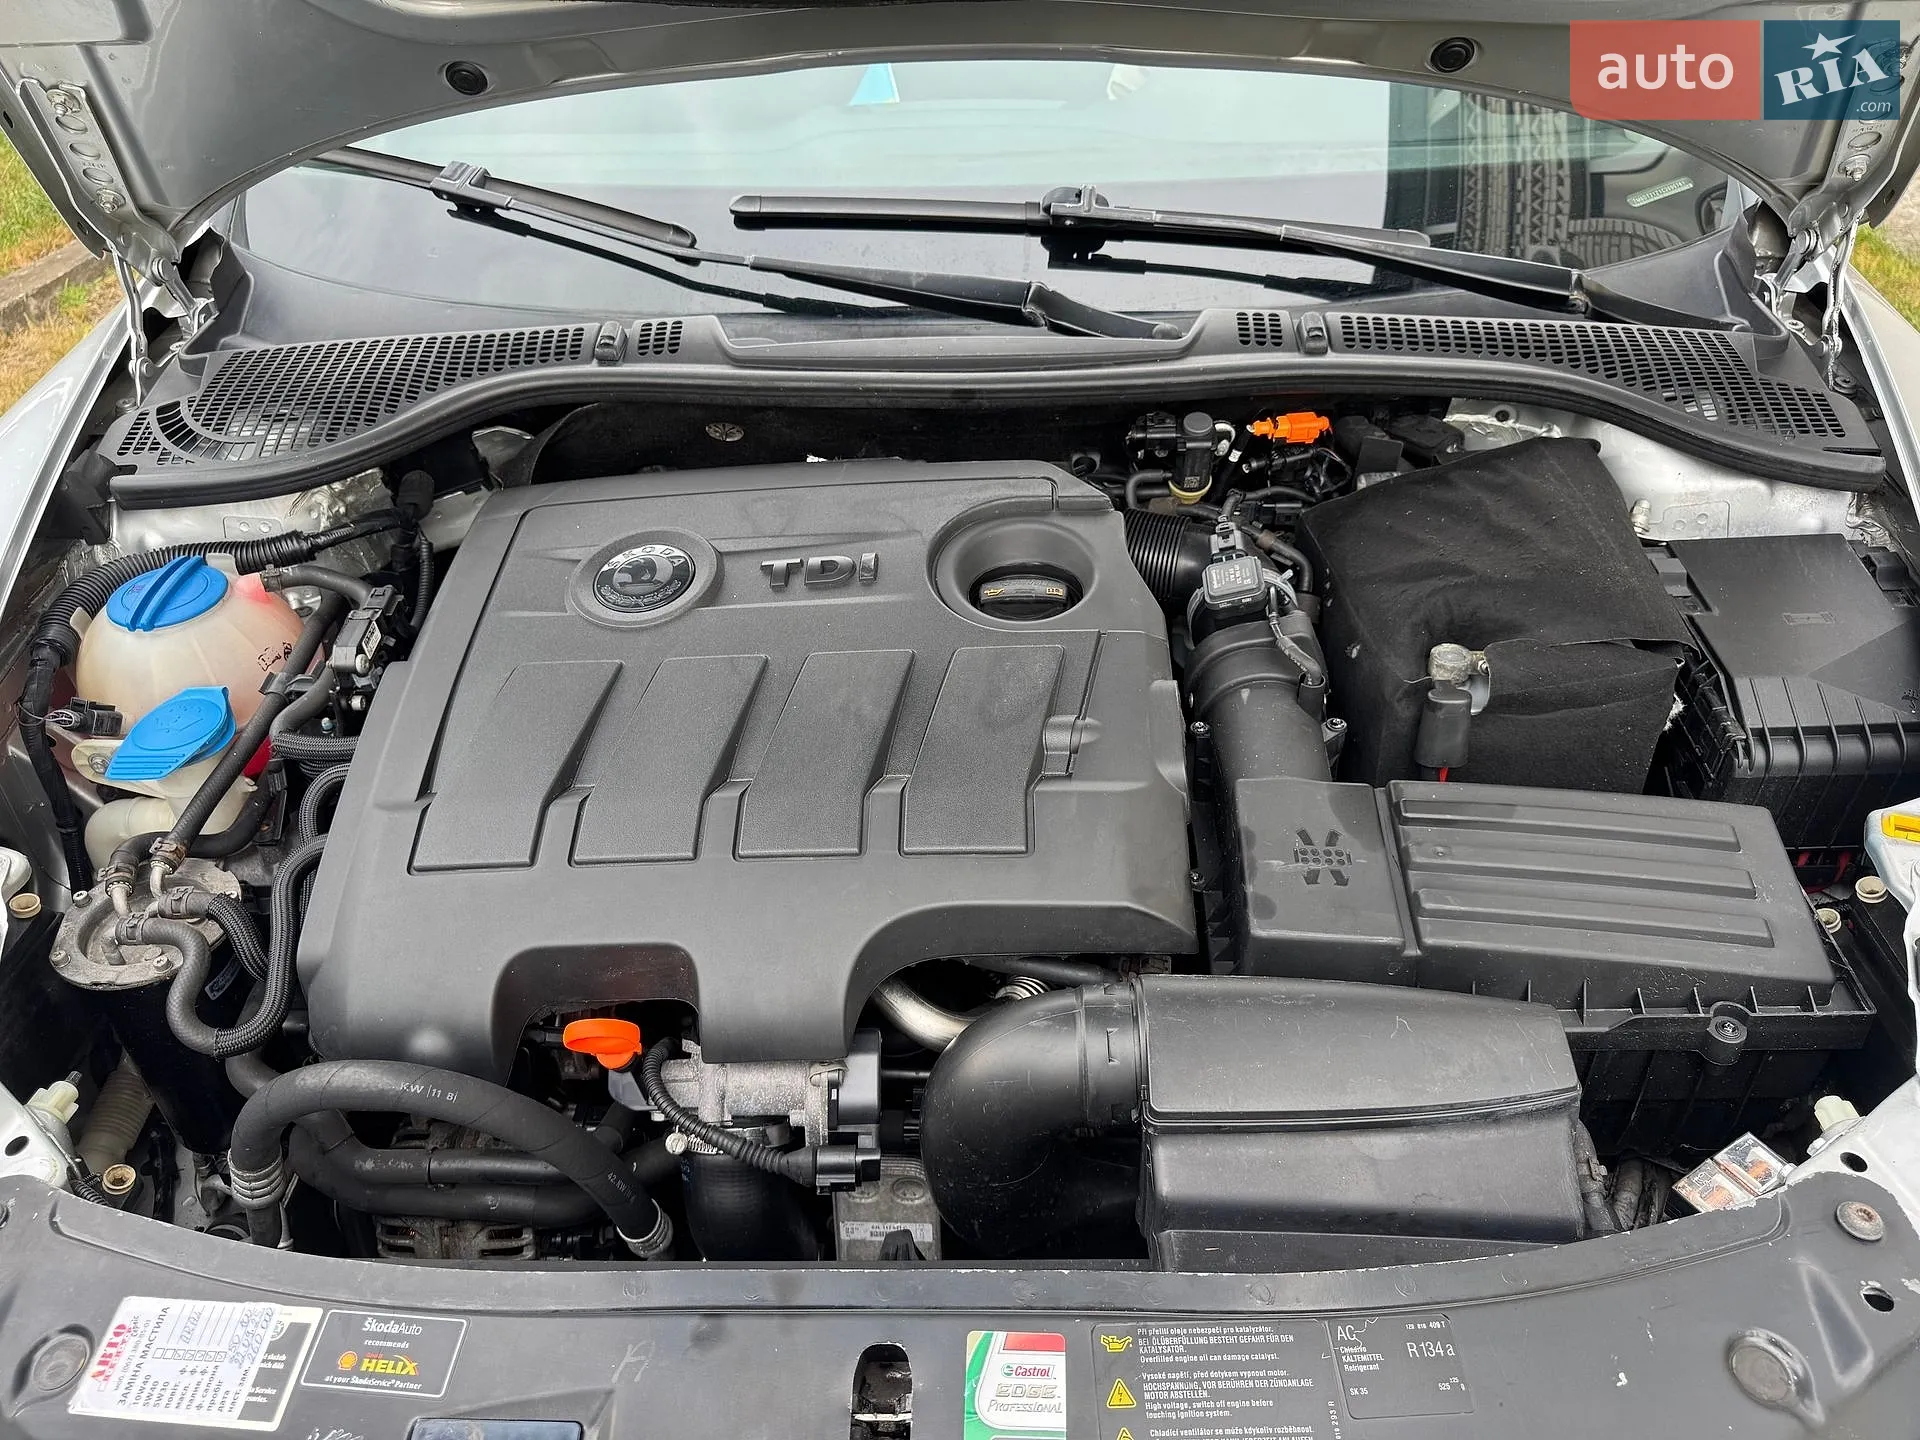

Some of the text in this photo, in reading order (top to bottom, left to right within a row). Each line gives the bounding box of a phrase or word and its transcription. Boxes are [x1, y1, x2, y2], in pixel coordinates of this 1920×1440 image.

[760, 552, 879, 588] TDI
[362, 1317, 422, 1335] ŠkodaAuto
[364, 1340, 410, 1349] recommends
[1138, 1338, 1149, 1346] BEI
[1209, 1335, 1238, 1344] BESTEHT
[1239, 1334, 1266, 1343] GEFAHR
[1266, 1333, 1280, 1342] FÜR
[1280, 1334, 1294, 1342] DEN
[91, 1324, 127, 1379] АВТО
[118, 1307, 170, 1405] ЗАМІНА МАСТИЛА
[1139, 1345, 1187, 1354] KATALYSATOR.
[1406, 1342, 1419, 1358] R
[1140, 1355, 1174, 1363] Overfilled
[1222, 1354, 1250, 1362] damage
[1250, 1353, 1280, 1361] catalyst.
[360, 1358, 418, 1376] HELIX
[1014, 1366, 1051, 1377] Castrol
[1343, 1363, 1380, 1372] Refrigerant
[202, 1365, 220, 1398] салона
[332, 1375, 351, 1384] your
[394, 1380, 423, 1389] Partner
[1142, 1371, 1167, 1380] Vysoké
[1209, 1370, 1239, 1379] dotykem
[1239, 1370, 1267, 1378] vypnout
[132, 1374, 151, 1405] 10W40
[995, 1383, 1057, 1398] EDGE
[1202, 1381, 1217, 1389] VOR
[1217, 1379, 1254, 1389] BERÜHREN
[1254, 1380, 1269, 1388] DER
[1269, 1378, 1314, 1387] ZÜNDANLAGE
[1438, 1382, 1451, 1391] 525
[142, 1381, 159, 1406] 5W40
[152, 1381, 169, 1407] 5W30
[206, 1379, 223, 1411] пробіг
[1144, 1389, 1211, 1400] MOTOR ABSTELLEN.
[1349, 1387, 1369, 1396] SK 35
[217, 1390, 230, 1412] дата
[1145, 1402, 1162, 1411] High
[1162, 1402, 1192, 1411] voltage,
[1226, 1400, 1250, 1409] engine
[1251, 1399, 1274, 1407] before
[1146, 1409, 1233, 1419] touching ignition system.
[1329, 1409, 1339, 1426] 293
